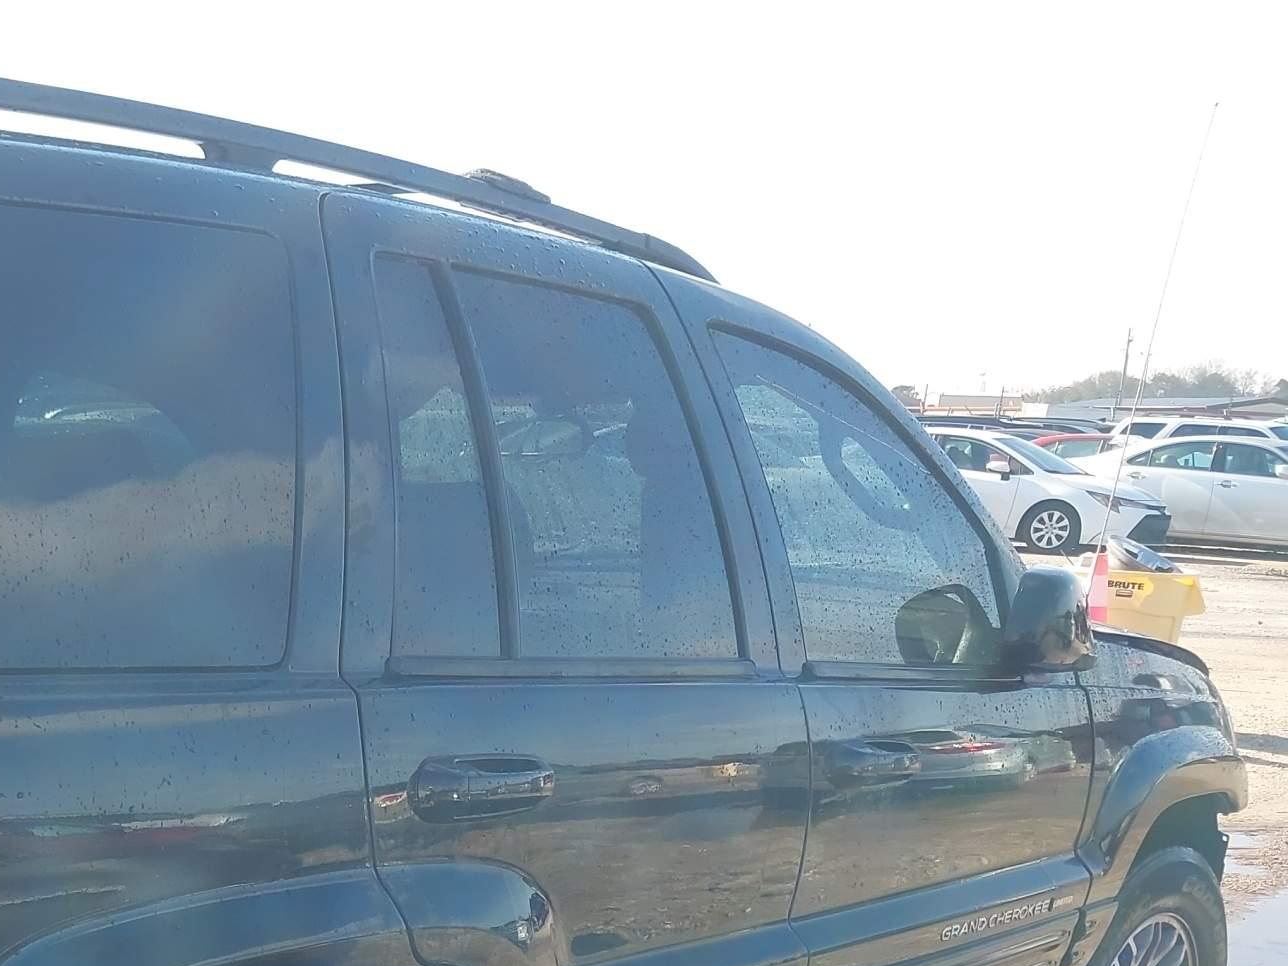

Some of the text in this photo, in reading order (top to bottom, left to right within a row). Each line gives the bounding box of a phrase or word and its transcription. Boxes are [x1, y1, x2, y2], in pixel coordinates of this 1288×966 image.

[1107, 579, 1145, 591] BRUTE
[941, 917, 988, 942] GRAND
[988, 899, 1051, 928] CHEROKEE
